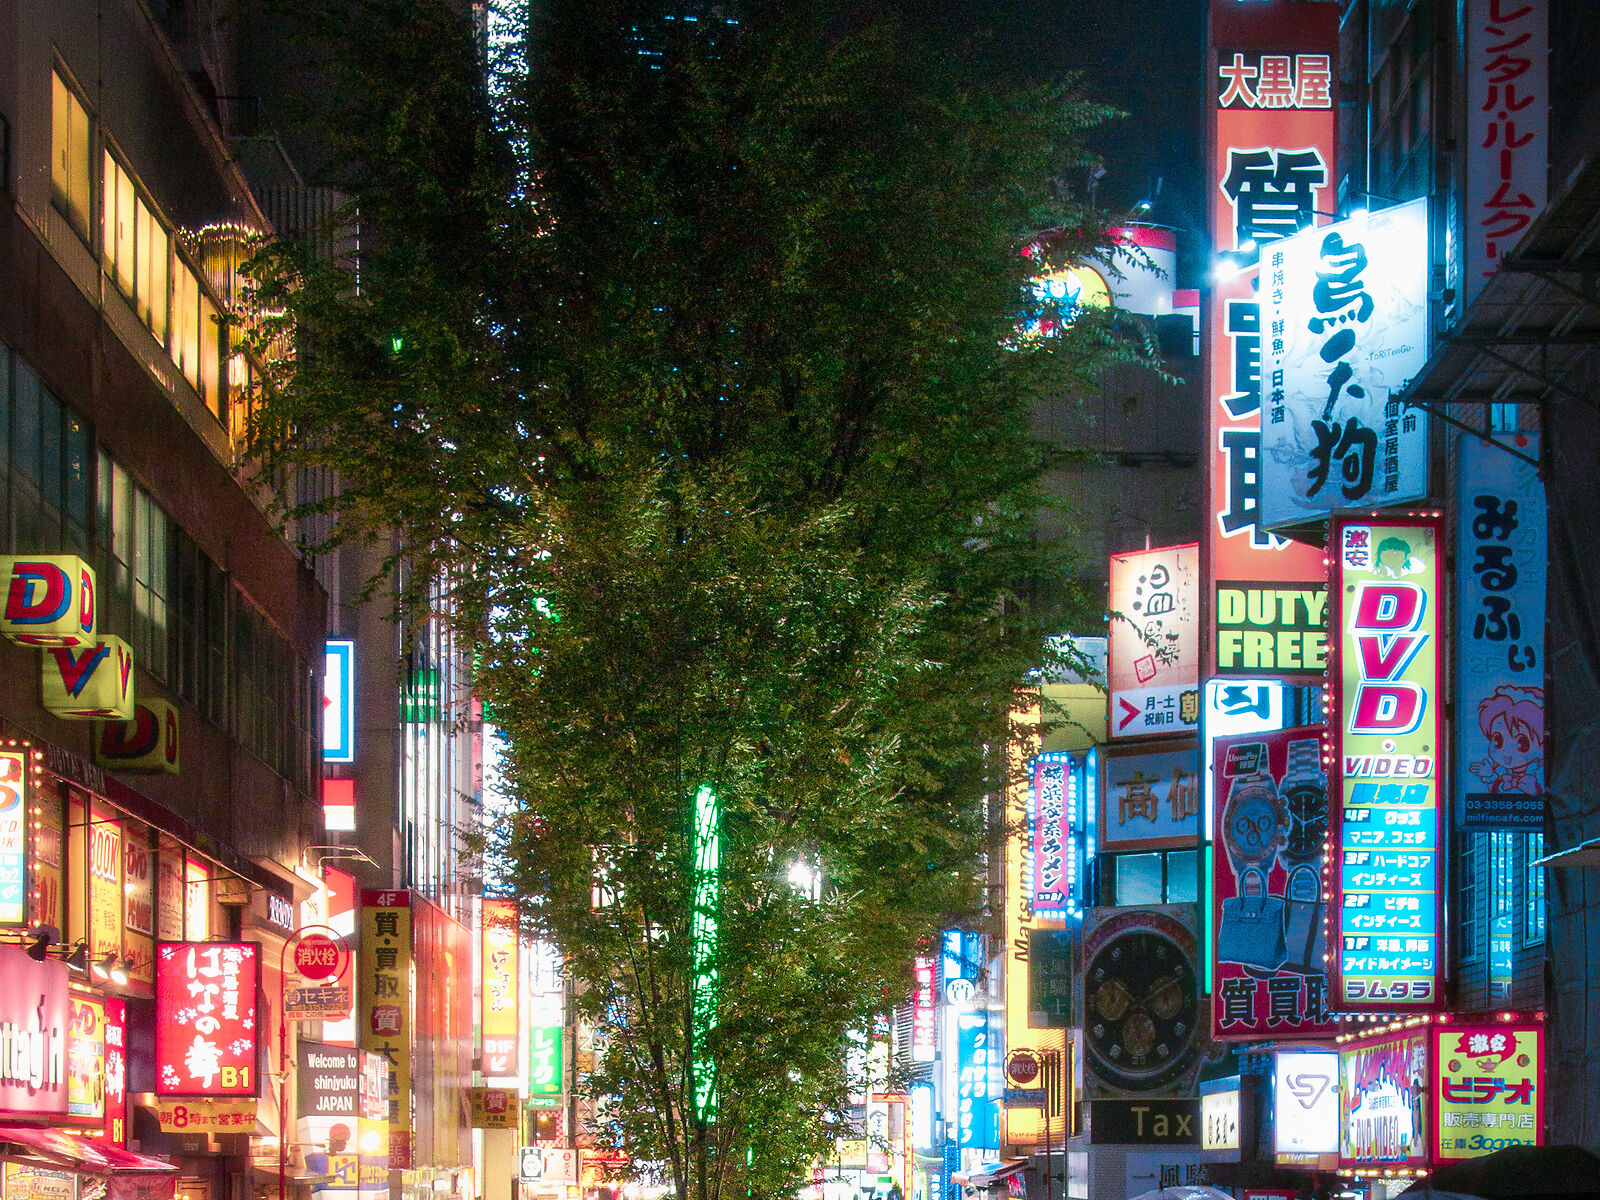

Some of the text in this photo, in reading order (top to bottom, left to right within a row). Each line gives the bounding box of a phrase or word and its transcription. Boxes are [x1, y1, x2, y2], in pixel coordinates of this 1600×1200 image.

[1219, 53, 1332, 108] 大黒屋
[1271, 251, 1286, 425] 串焼き・鮮魚・日本酒
[1385, 402, 1399, 493] 個室居酒屋
[1345, 530, 1369, 567] 激安
[1218, 589, 1328, 626] DUTY
[1218, 631, 1328, 669] FREE
[1347, 580, 1430, 736] DVD
[1144, 712, 1175, 727] 祝前日
[1344, 755, 1434, 778] VIDEO
[1466, 800, 1544, 810] 03-3358-9055
[1345, 809, 1369, 822] 4F
[1345, 852, 1431, 868] 3F ハードコア
[1351, 873, 1422, 886] インディーズ
[376, 893, 396, 906] 4F
[1344, 895, 1370, 908] 2F
[1351, 914, 1422, 928] インディーズ
[1345, 938, 1369, 950] 1F
[297, 947, 337, 966] 消火栓
[373, 912, 399, 999] 質・買取
[1343, 957, 1433, 971] アイドルイメージ
[301, 988, 348, 1004] セキネ
[1346, 980, 1431, 999] ラムタラ
[1220, 974, 1333, 1028] 質買取
[308, 1053, 357, 1068] Welcome to
[532, 1029, 553, 1085] レイク
[221, 1065, 249, 1088] B1
[314, 1075, 357, 1091] shinjyuku
[1442, 1076, 1535, 1105] ビデオ
[316, 1096, 353, 1111] JAPAN
[160, 1105, 256, 1128] 朝8時まで営業中
[1131, 1107, 1193, 1137] Tax
[1443, 1112, 1534, 1128] 販売専門店
[113, 1118, 123, 1143] B1
